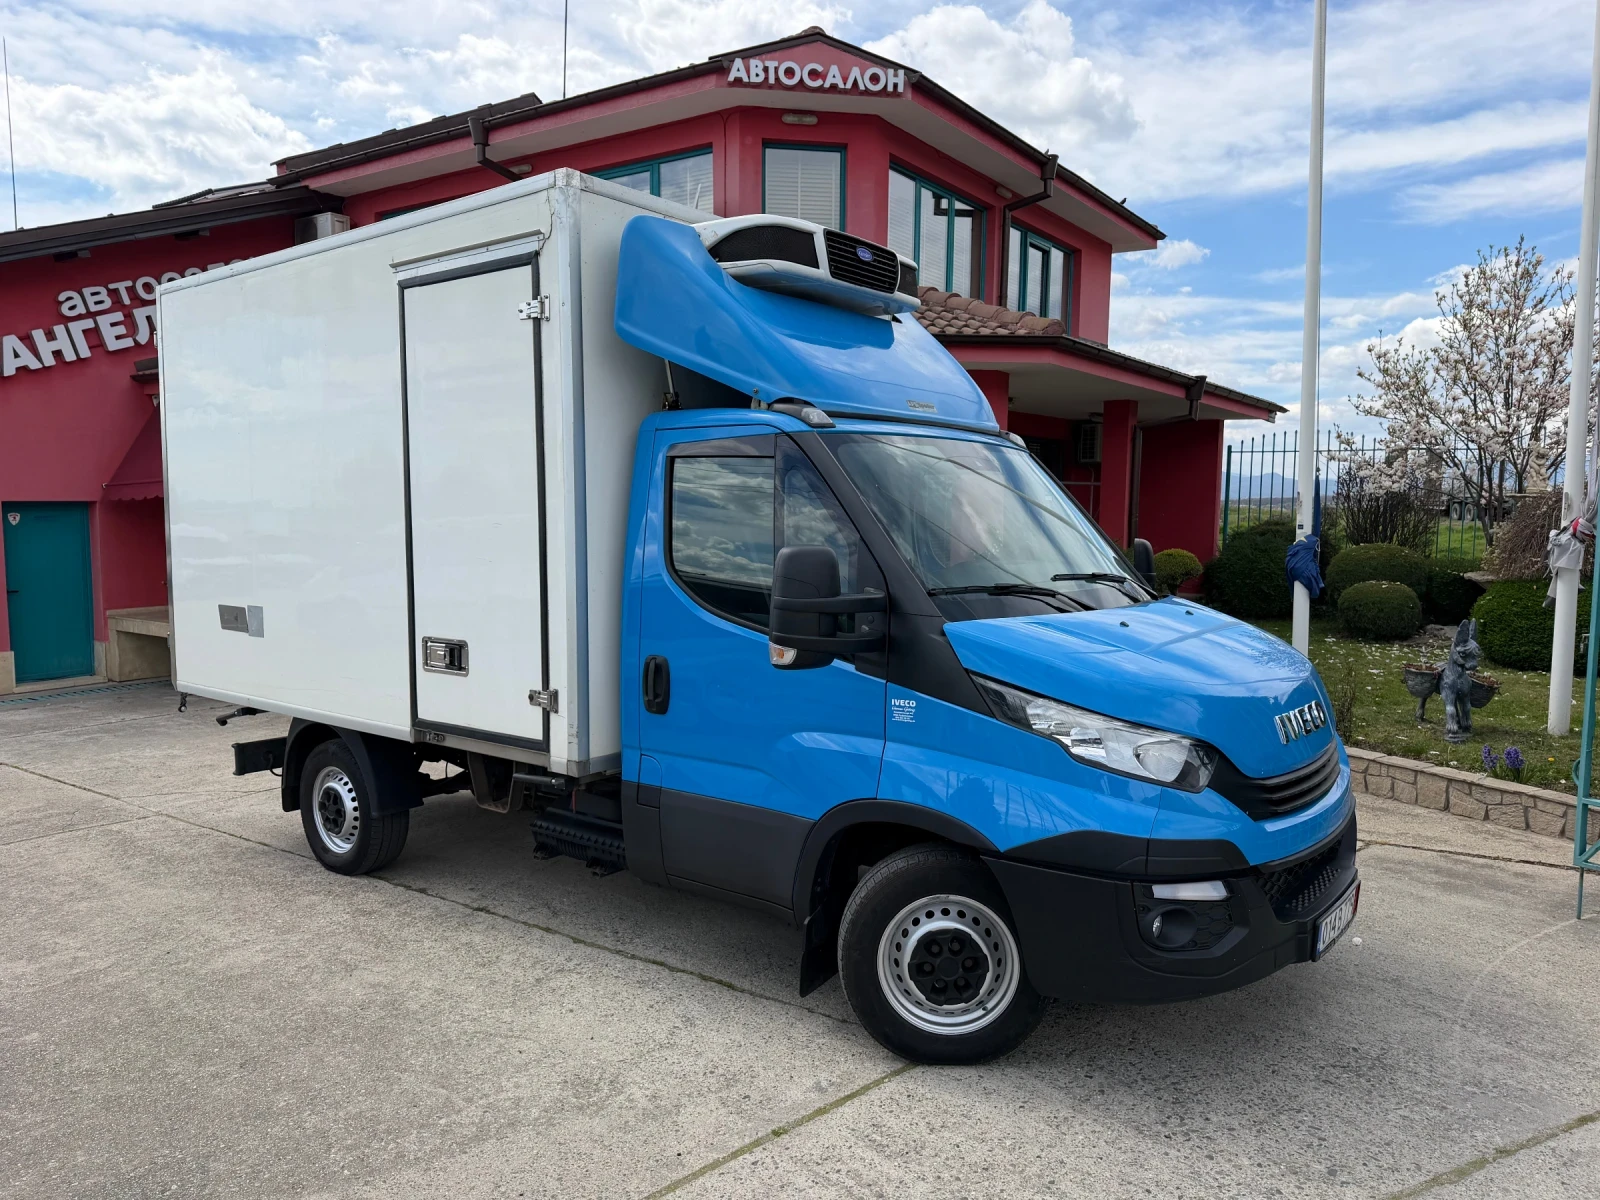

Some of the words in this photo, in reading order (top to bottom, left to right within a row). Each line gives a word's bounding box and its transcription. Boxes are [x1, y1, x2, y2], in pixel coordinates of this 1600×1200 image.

[727, 57, 904, 93] АВТОСАЛОН
[891, 698, 916, 707] IVECO
[1274, 700, 1326, 744] IVECO
